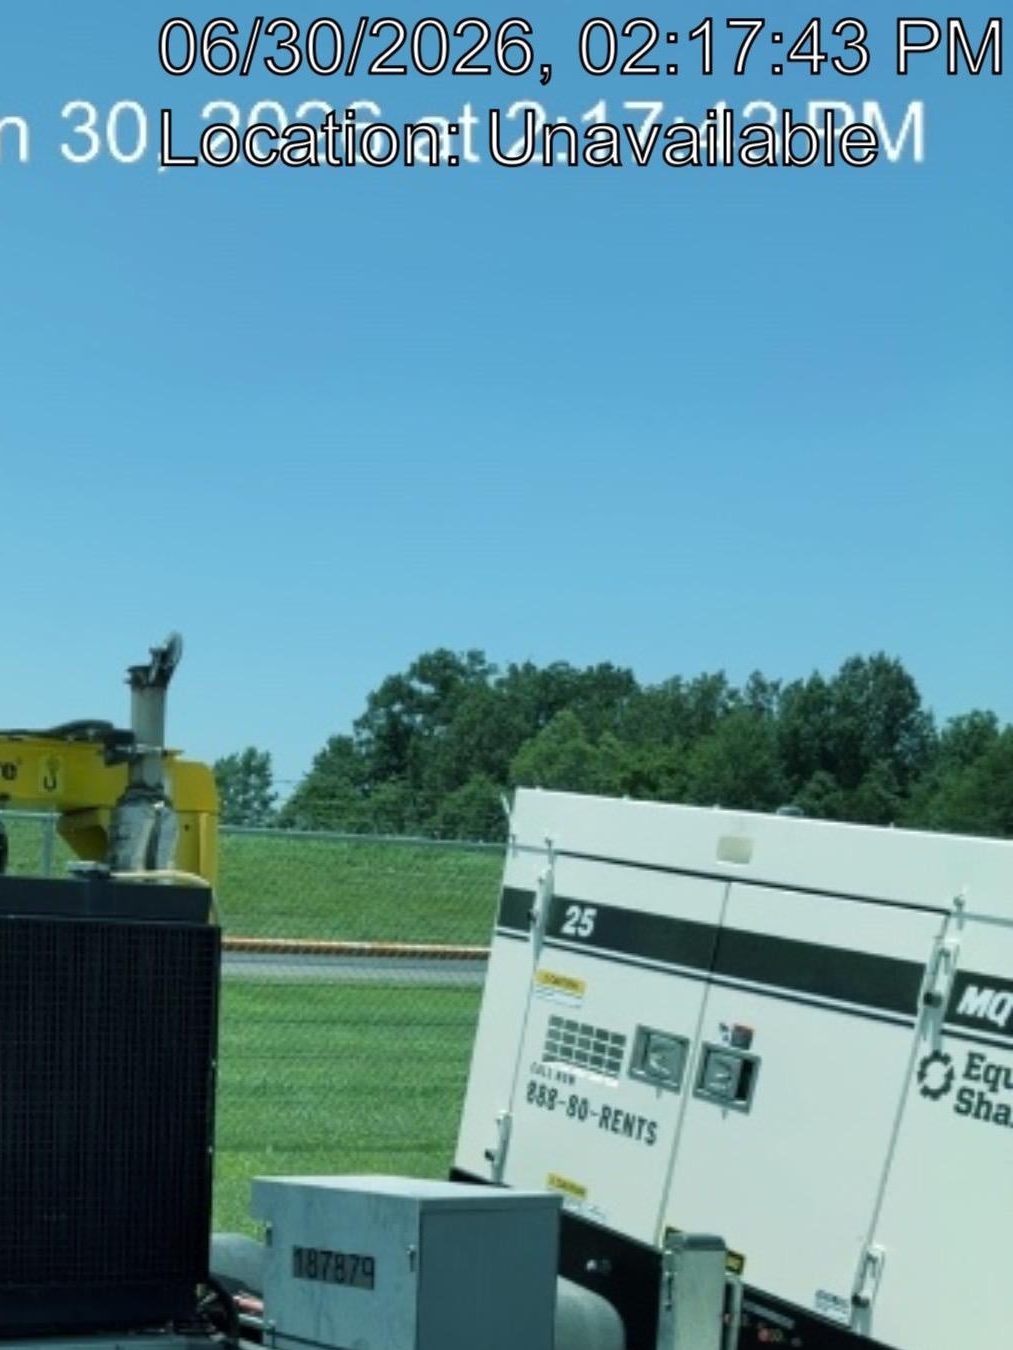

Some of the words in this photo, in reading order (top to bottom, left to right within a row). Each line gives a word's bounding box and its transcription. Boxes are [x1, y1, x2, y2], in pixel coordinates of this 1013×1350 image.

[561, 905, 597, 937] 25
[526, 1080, 658, 1146] 888-80-RENTS
[953, 1086, 1013, 1128] Sha
[294, 1246, 375, 1291] 187879
